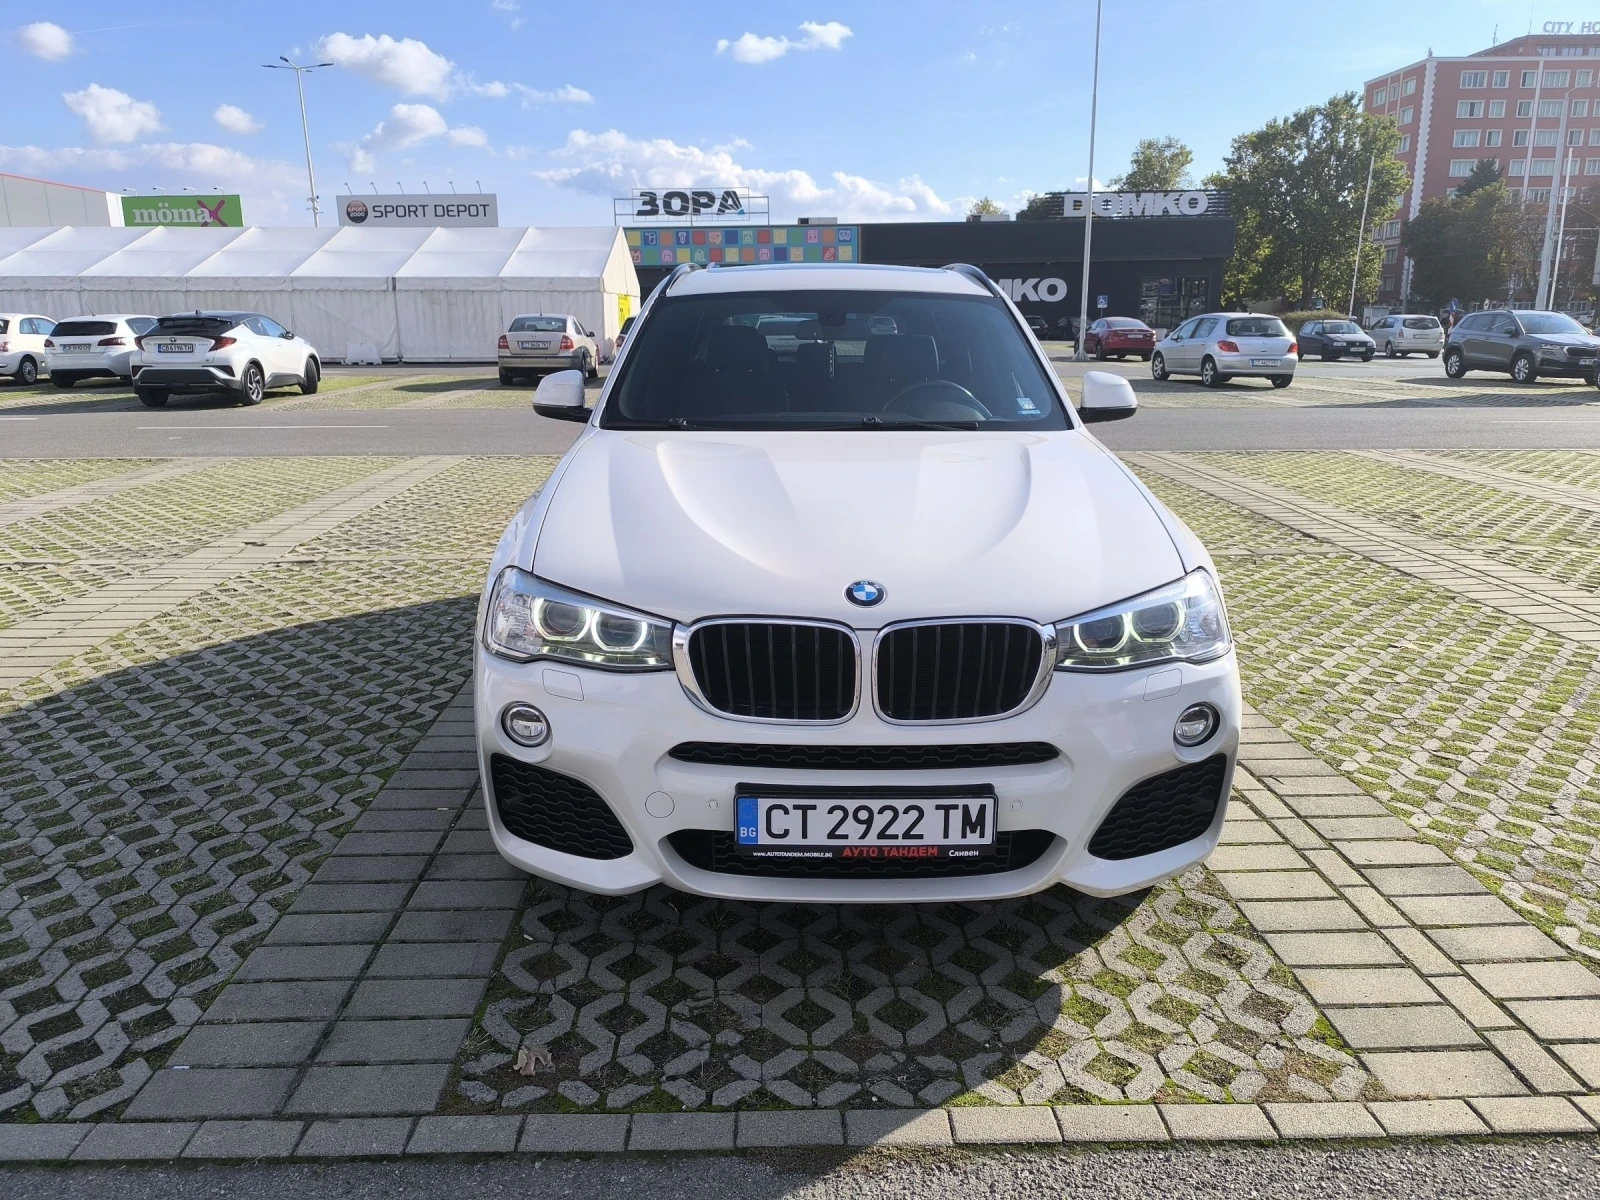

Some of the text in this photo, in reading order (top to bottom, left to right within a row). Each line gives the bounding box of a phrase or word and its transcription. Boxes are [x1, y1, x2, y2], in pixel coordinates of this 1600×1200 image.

[1543, 21, 1574, 33] CITY
[1064, 191, 1209, 217] DOMKO
[372, 204, 490, 218] SPORT DEPOT
[766, 804, 987, 840] CT 2922 TM
[740, 827, 757, 837] BG
[842, 847, 938, 858] АУТО ТАНДЕМ
